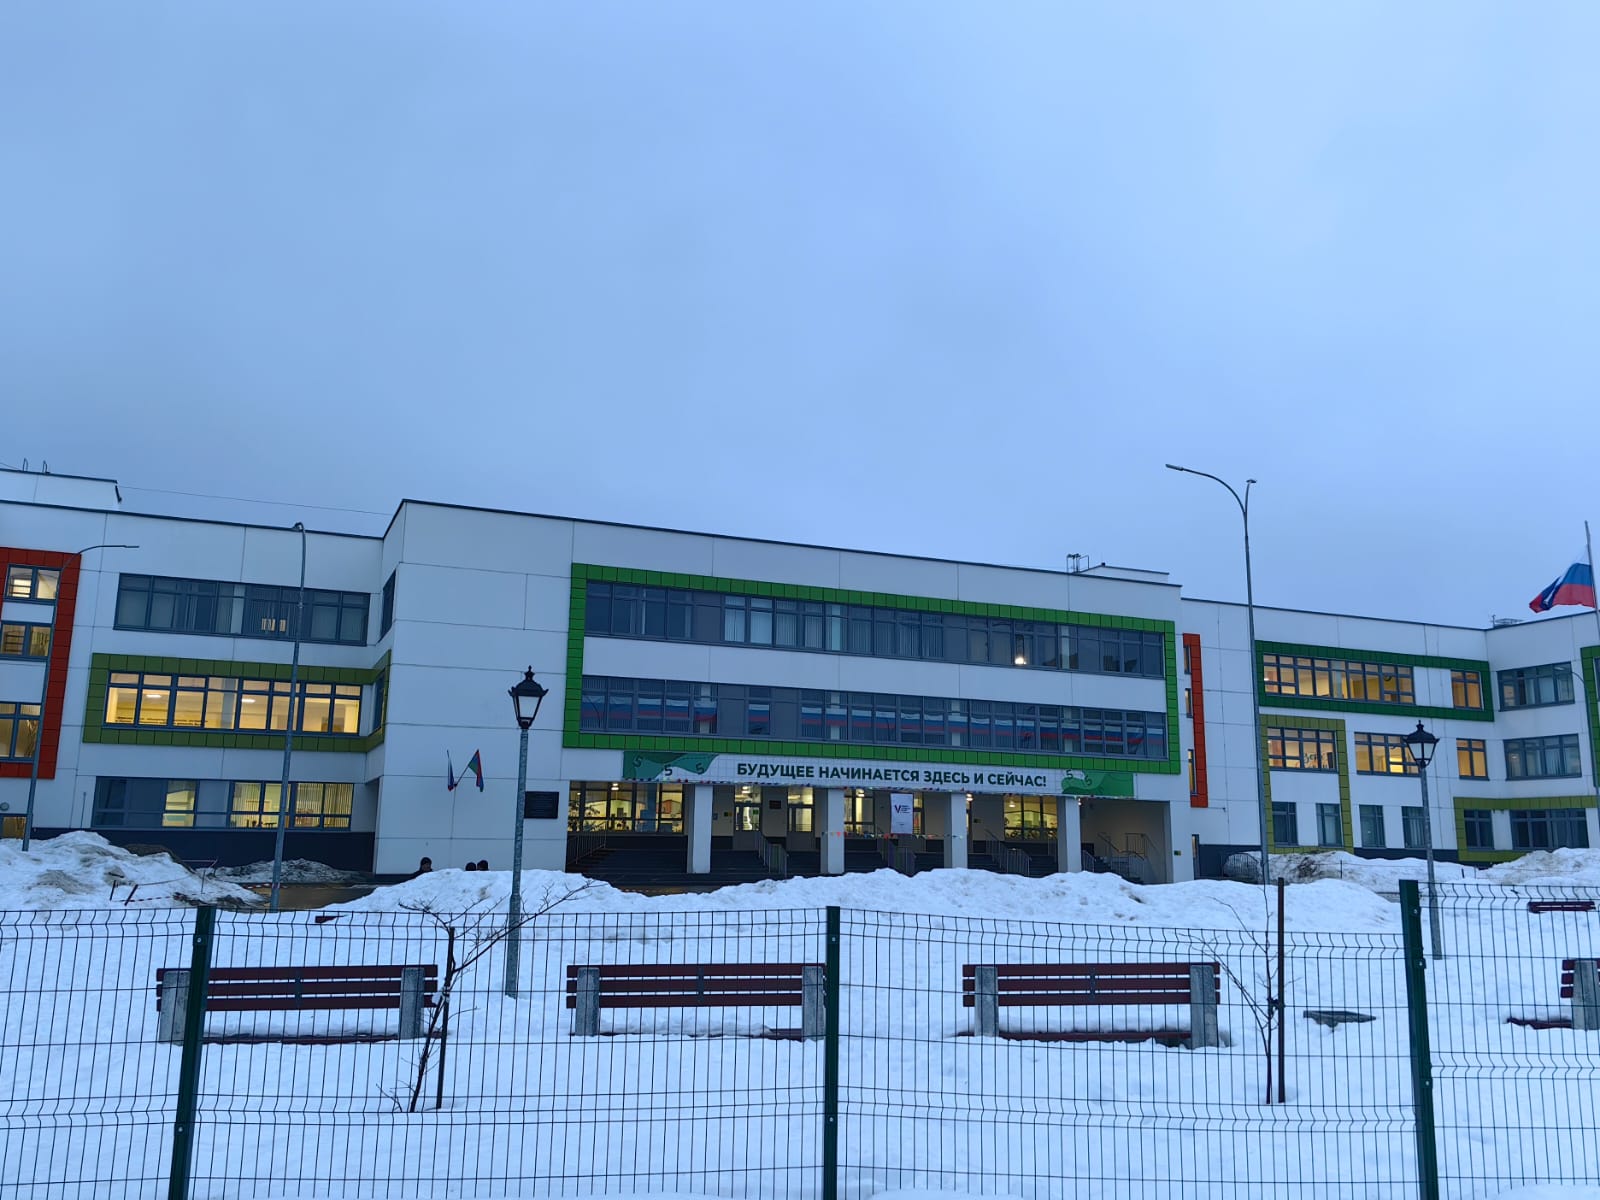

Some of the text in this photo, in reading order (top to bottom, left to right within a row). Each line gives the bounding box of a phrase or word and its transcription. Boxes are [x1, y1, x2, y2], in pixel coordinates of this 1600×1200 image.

[664, 764, 673, 776] 5
[696, 763, 705, 775] 5
[737, 763, 1046, 787] БУДУЩЕЕ НАЧИНАЕТСЯ ЗДЕСЬ И СЕЙЧАС!
[1066, 769, 1074, 779] 5
